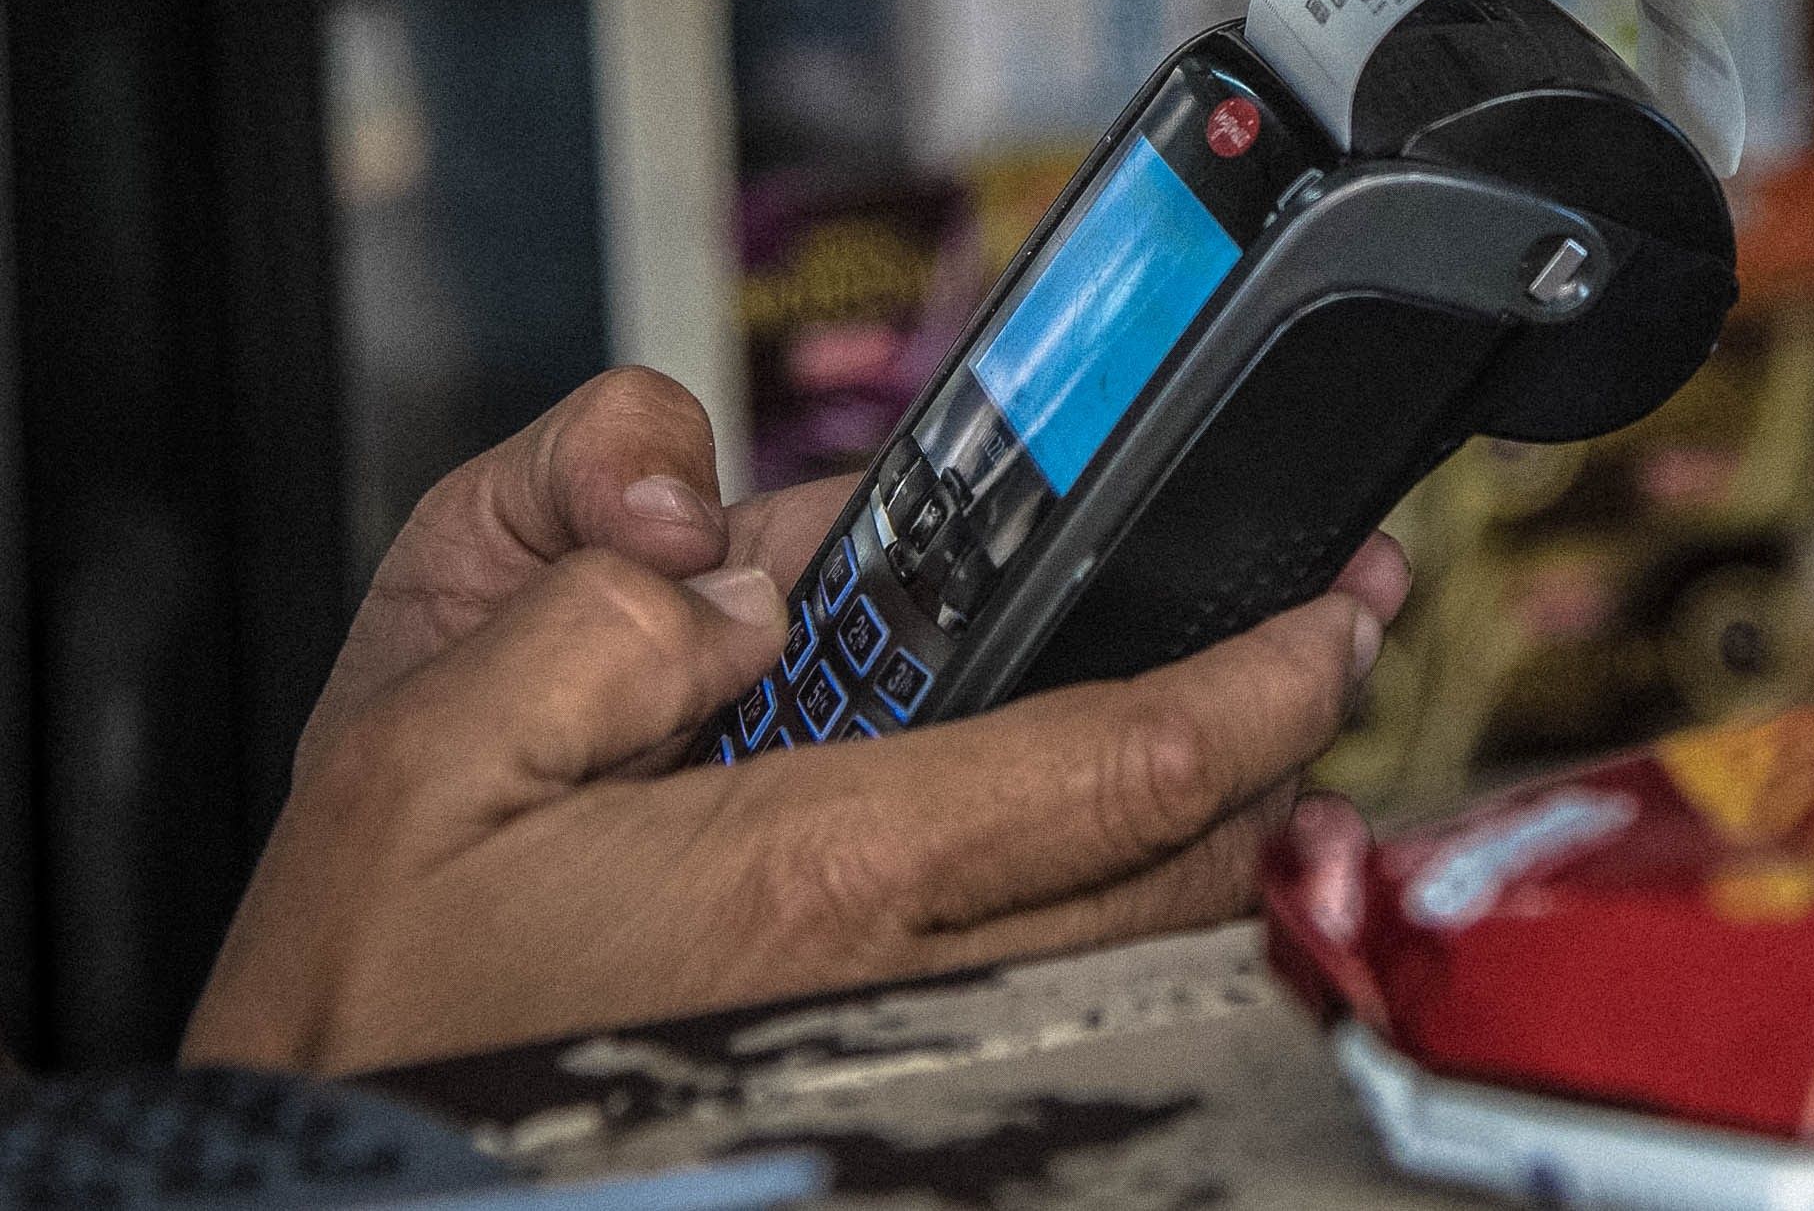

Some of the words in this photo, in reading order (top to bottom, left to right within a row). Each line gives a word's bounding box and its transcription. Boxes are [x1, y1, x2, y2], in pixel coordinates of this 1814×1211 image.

[826, 554, 843, 579] 1
[847, 615, 865, 645] 2
[887, 662, 908, 691] 3
[807, 679, 825, 708] 5
